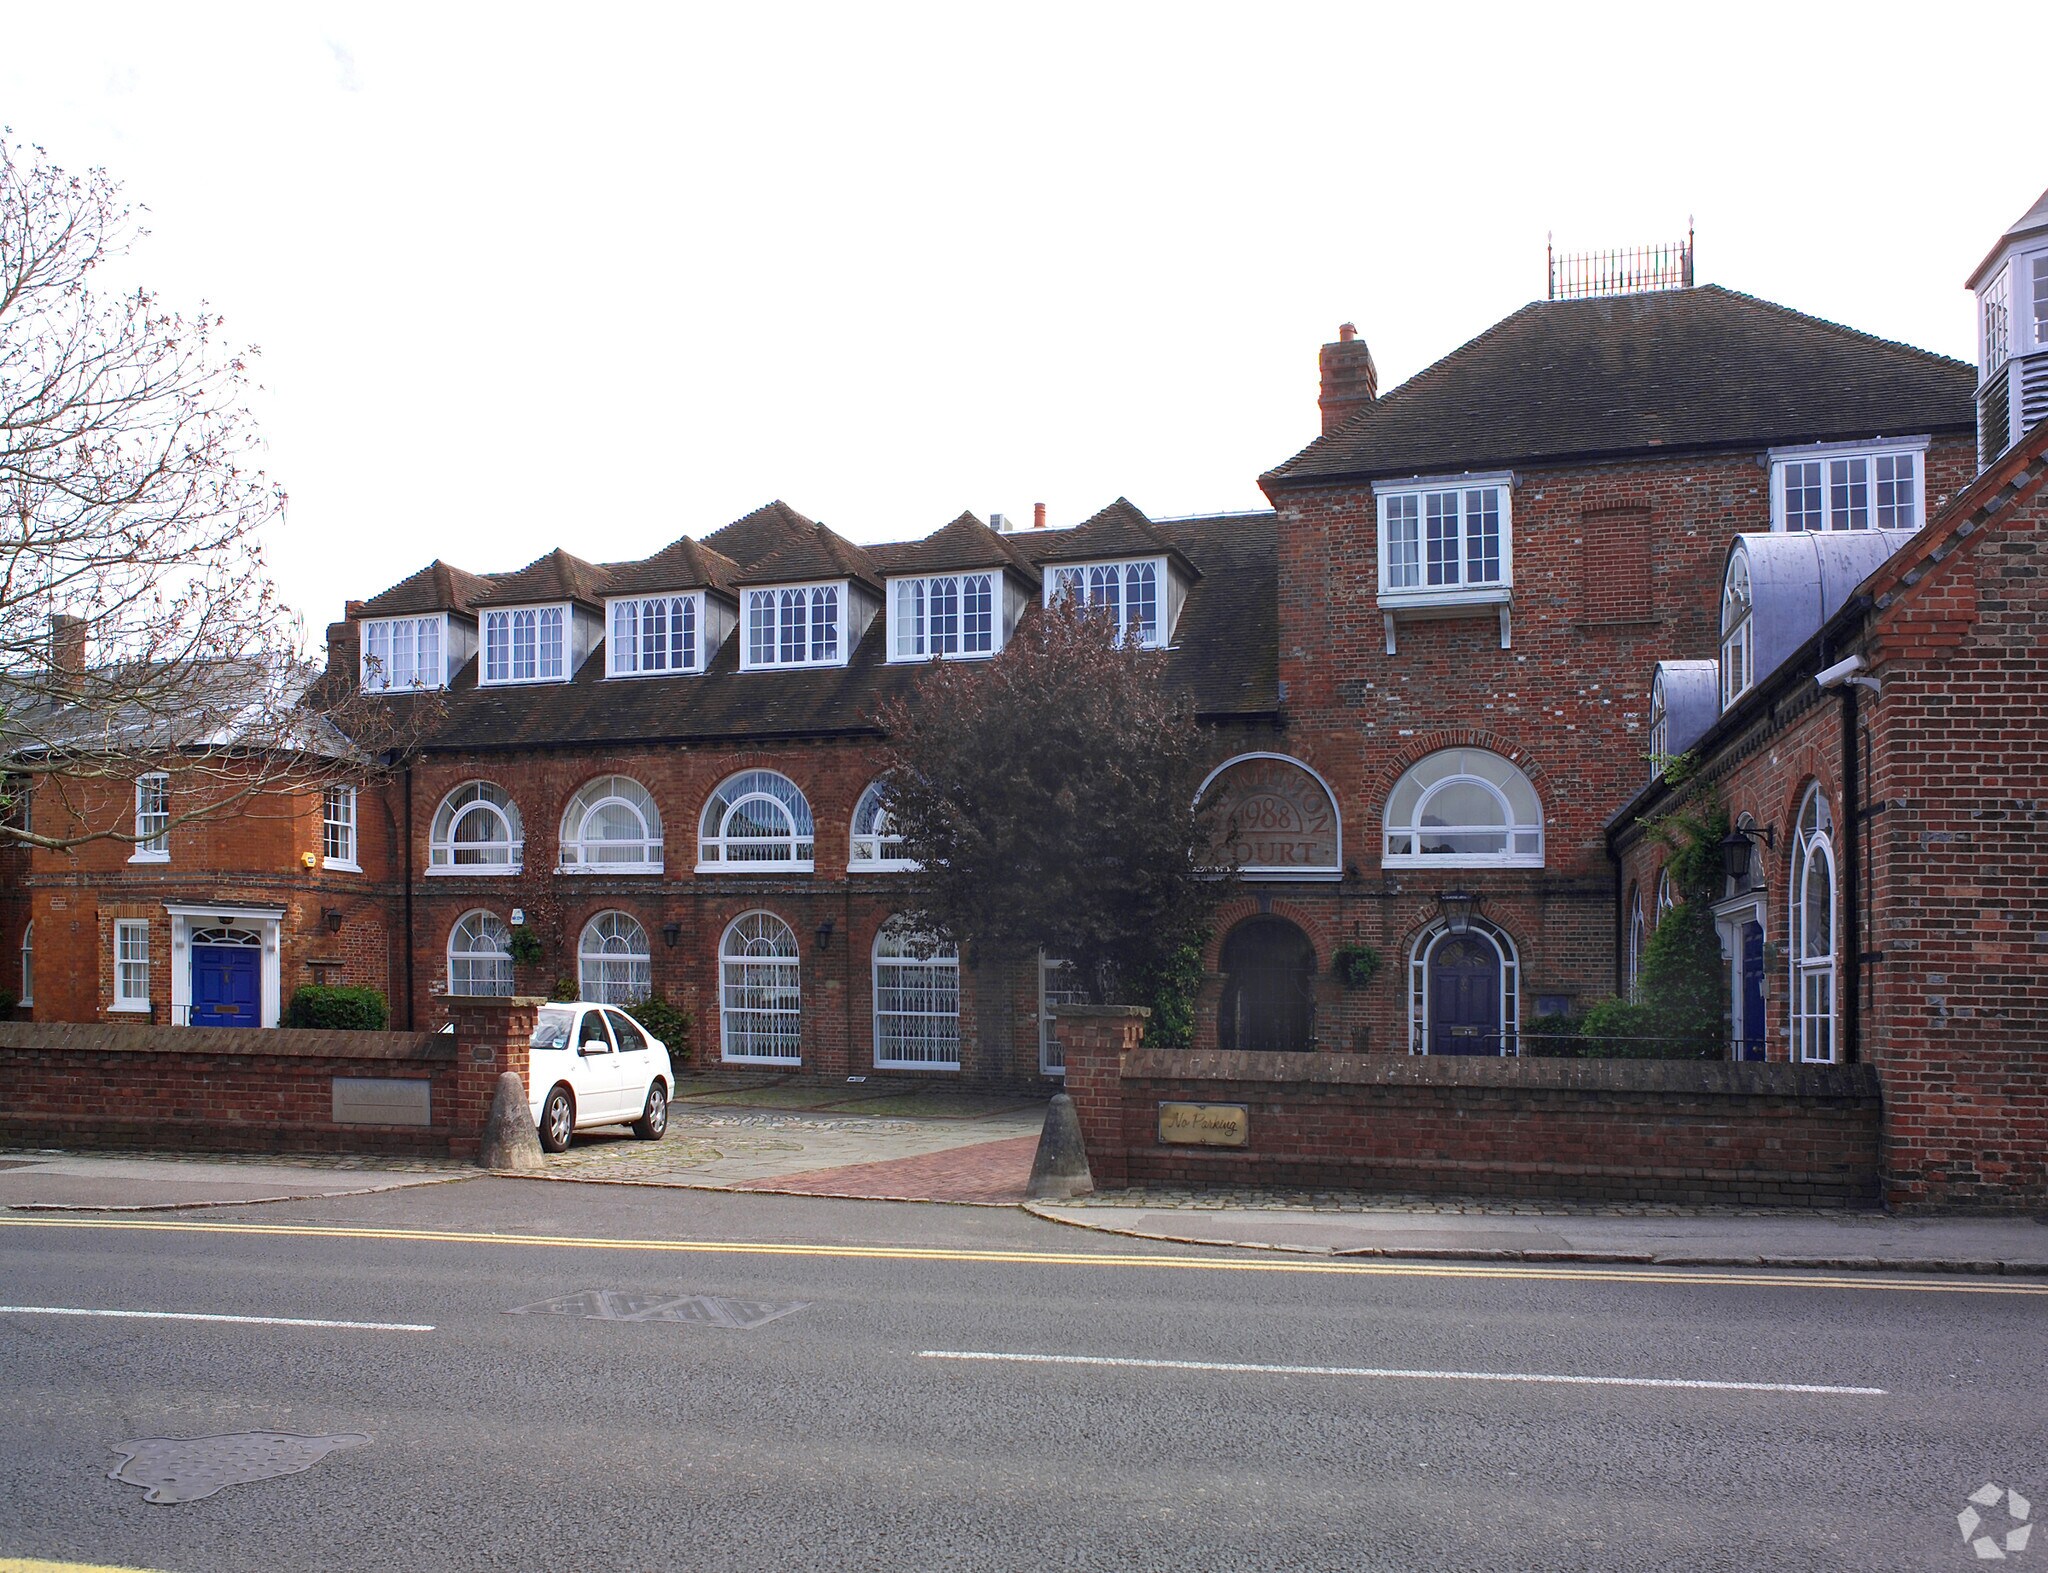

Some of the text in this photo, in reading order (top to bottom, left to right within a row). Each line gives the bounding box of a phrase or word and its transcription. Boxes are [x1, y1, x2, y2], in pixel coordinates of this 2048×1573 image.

[1239, 798, 1291, 829] 1988
[1212, 842, 1317, 863] COURT
[1168, 1112, 1238, 1136] No Parking
